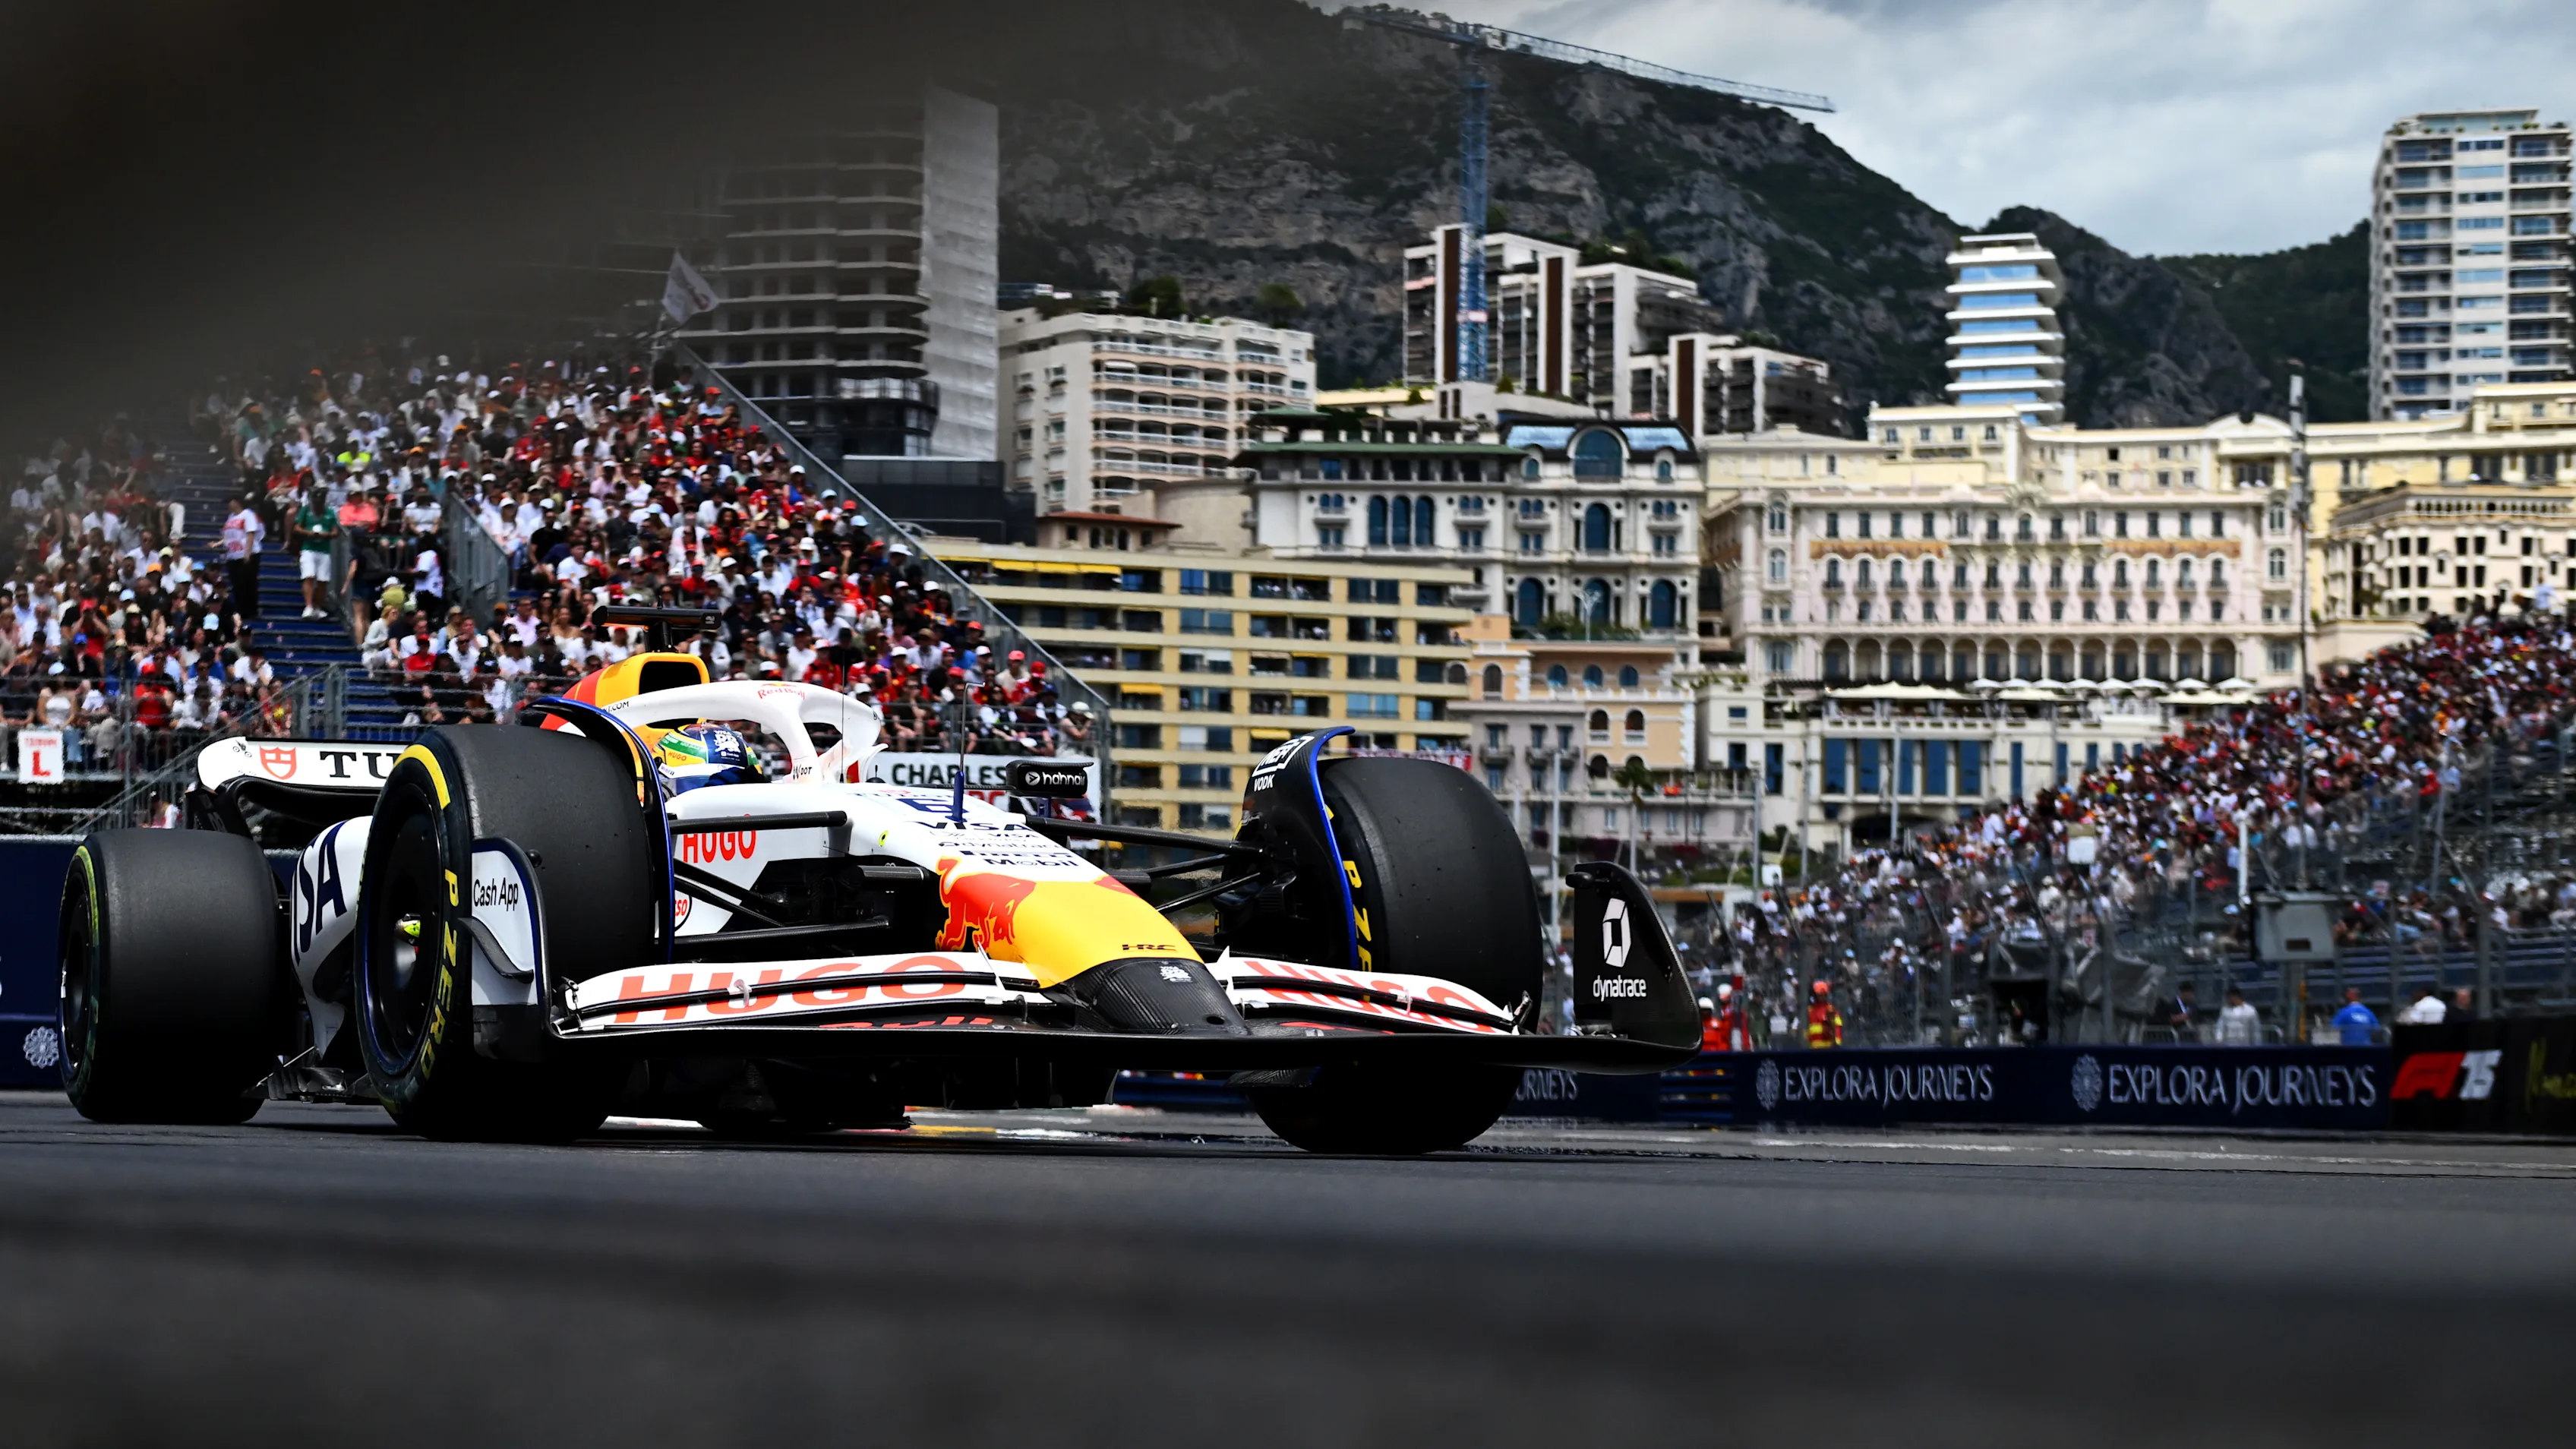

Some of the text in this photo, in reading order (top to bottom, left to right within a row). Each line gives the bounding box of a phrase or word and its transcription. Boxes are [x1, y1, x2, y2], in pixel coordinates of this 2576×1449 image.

[757, 687, 806, 700] Red Bull
[33, 750, 51, 776] L
[668, 750, 687, 762] HUGO
[892, 763, 1007, 786] CHARLES
[1042, 771, 1086, 786] hahnair
[683, 814, 756, 863] HUGO
[908, 822, 1034, 832] VISA
[473, 876, 519, 911] Cash App
[614, 955, 966, 1024] HUGO
[1593, 974, 1647, 1002] dynatrace
[1784, 1063, 1995, 1112] EXPLORA JOURNEYS
[2108, 1063, 2377, 1116] EXPLORA JOURNEYS
